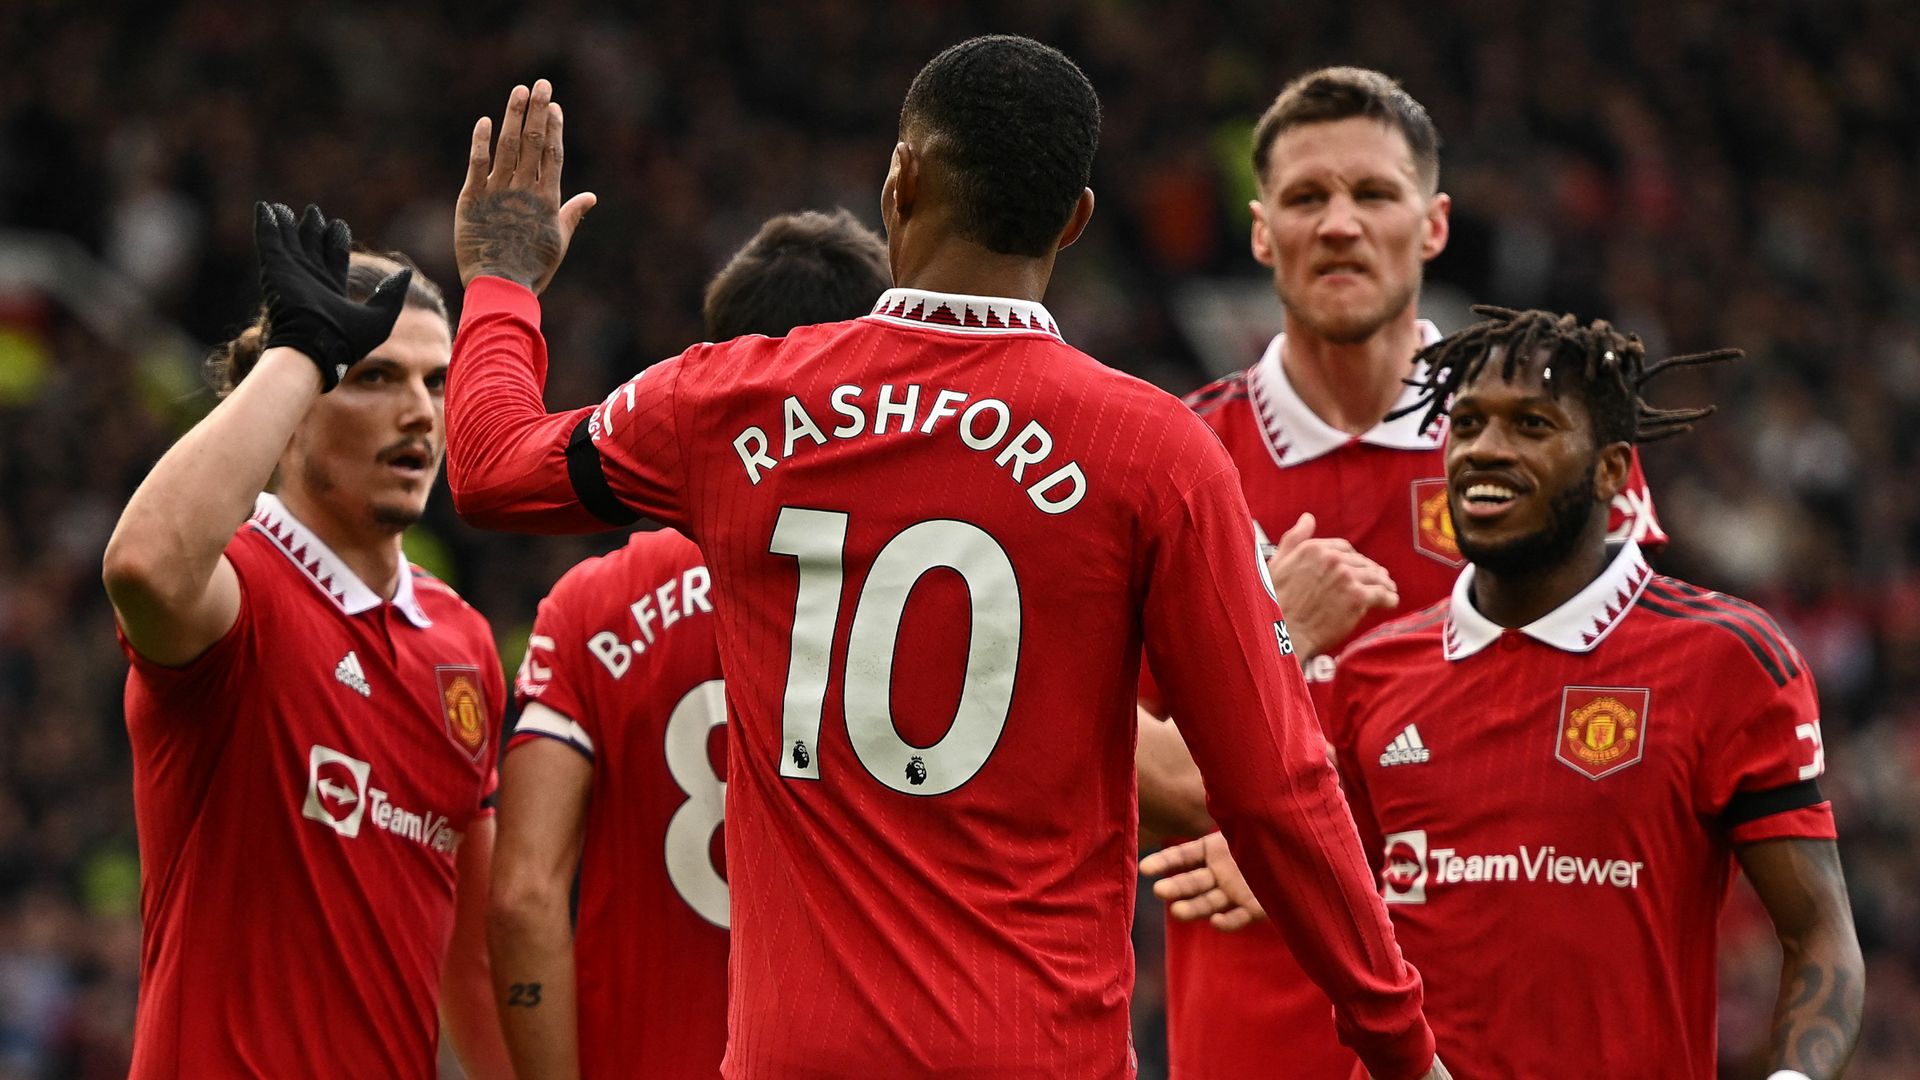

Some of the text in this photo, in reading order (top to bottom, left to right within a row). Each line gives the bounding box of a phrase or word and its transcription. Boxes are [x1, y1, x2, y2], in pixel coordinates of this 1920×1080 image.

[733, 383, 1087, 514] RASHFORD
[769, 506, 1022, 796] 10
[1379, 748, 1430, 767] adidas
[664, 679, 731, 930] 8
[1429, 845, 1643, 888] TeamViewer
[508, 982, 542, 1008] 23
